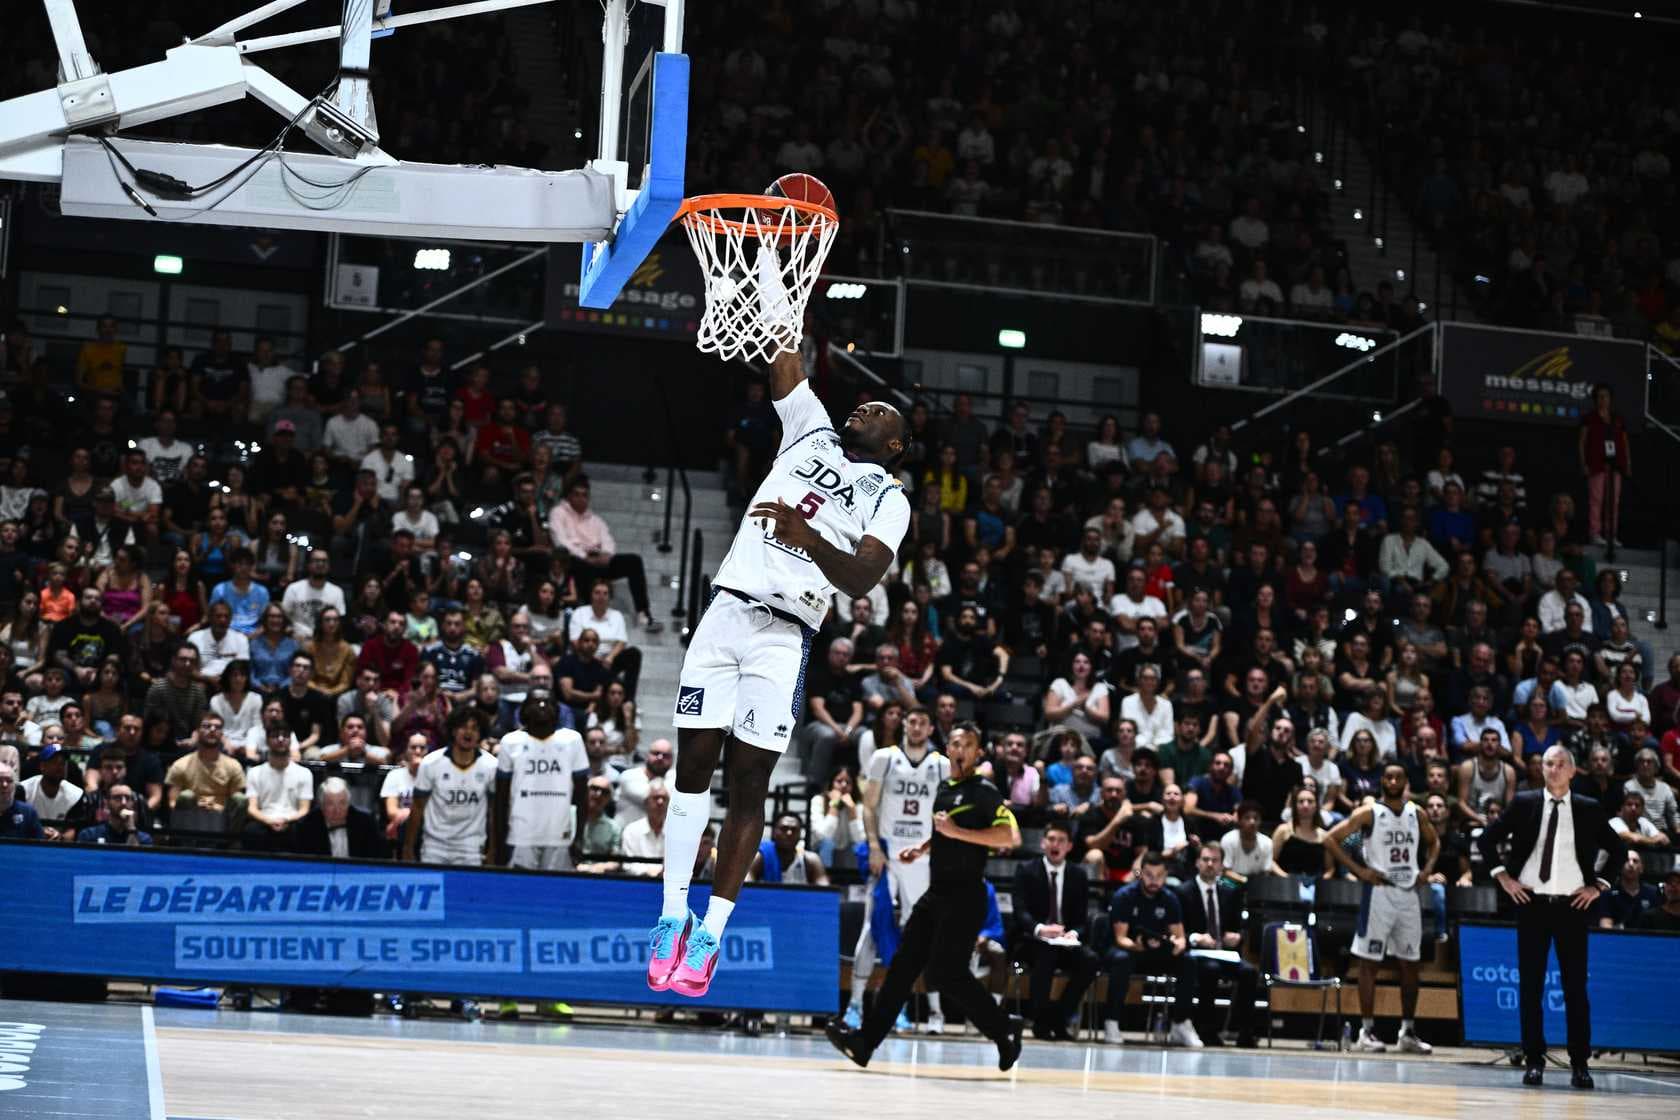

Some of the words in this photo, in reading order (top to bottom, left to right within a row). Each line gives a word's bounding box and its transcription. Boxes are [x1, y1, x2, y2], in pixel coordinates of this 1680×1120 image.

[564, 283, 696, 309] msage
[795, 459, 854, 508] JDA
[796, 491, 826, 520] 5
[525, 759, 561, 775] JDA
[448, 789, 479, 804] JDA
[893, 779, 929, 798] JDA
[903, 799, 919, 816] 13
[1384, 831, 1414, 845] JDA
[1390, 847, 1410, 863] 24
[78, 886, 130, 913] LE
[138, 878, 441, 913] DÉPARTEMENT
[182, 936, 345, 962] SOUTIENT
[357, 938, 399, 963] LE
[411, 939, 516, 964] SPORT
[537, 941, 580, 964] EN
[591, 934, 652, 964] CÔT
[708, 936, 766, 963] OR
